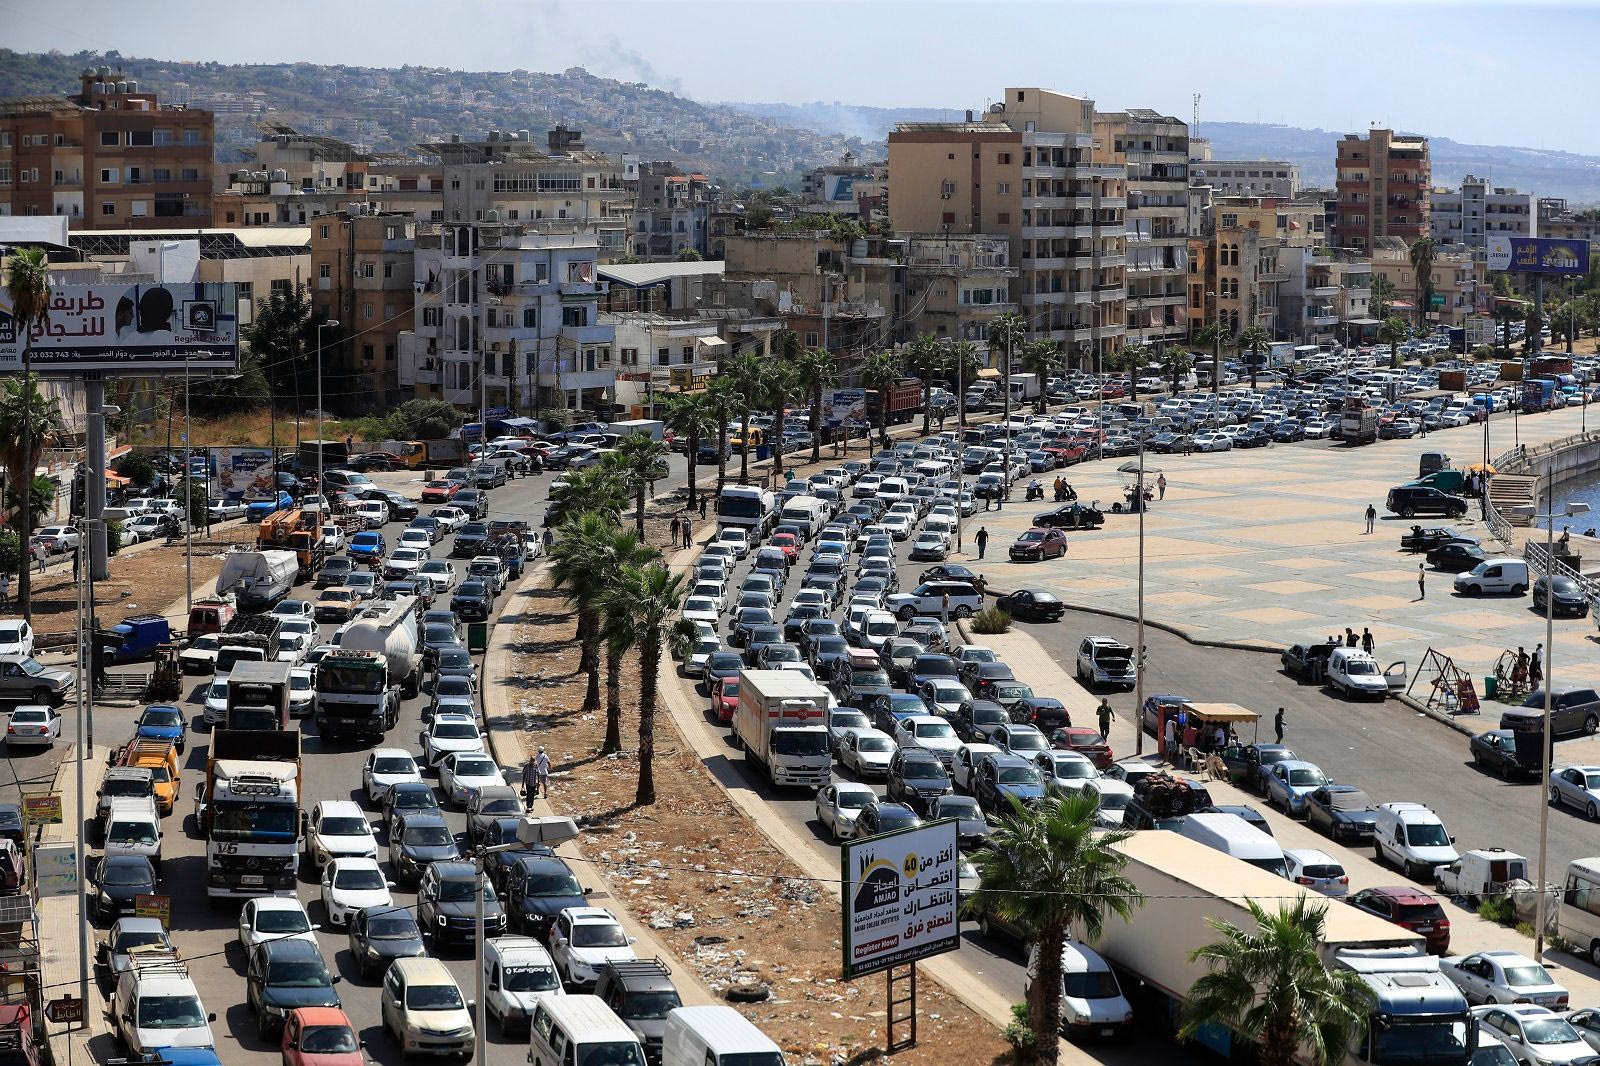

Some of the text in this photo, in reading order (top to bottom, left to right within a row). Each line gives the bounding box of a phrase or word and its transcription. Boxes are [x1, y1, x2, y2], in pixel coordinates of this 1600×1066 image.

[47, 291, 104, 316] طريق
[30, 316, 104, 342] للنجاح
[904, 858, 916, 871] 40
[920, 856, 933, 872] من
[904, 891, 952, 916] بانتظارك
[904, 919, 923, 940] فرق
[926, 911, 952, 933] لنصنع
[855, 936, 898, 955] Register Now!
